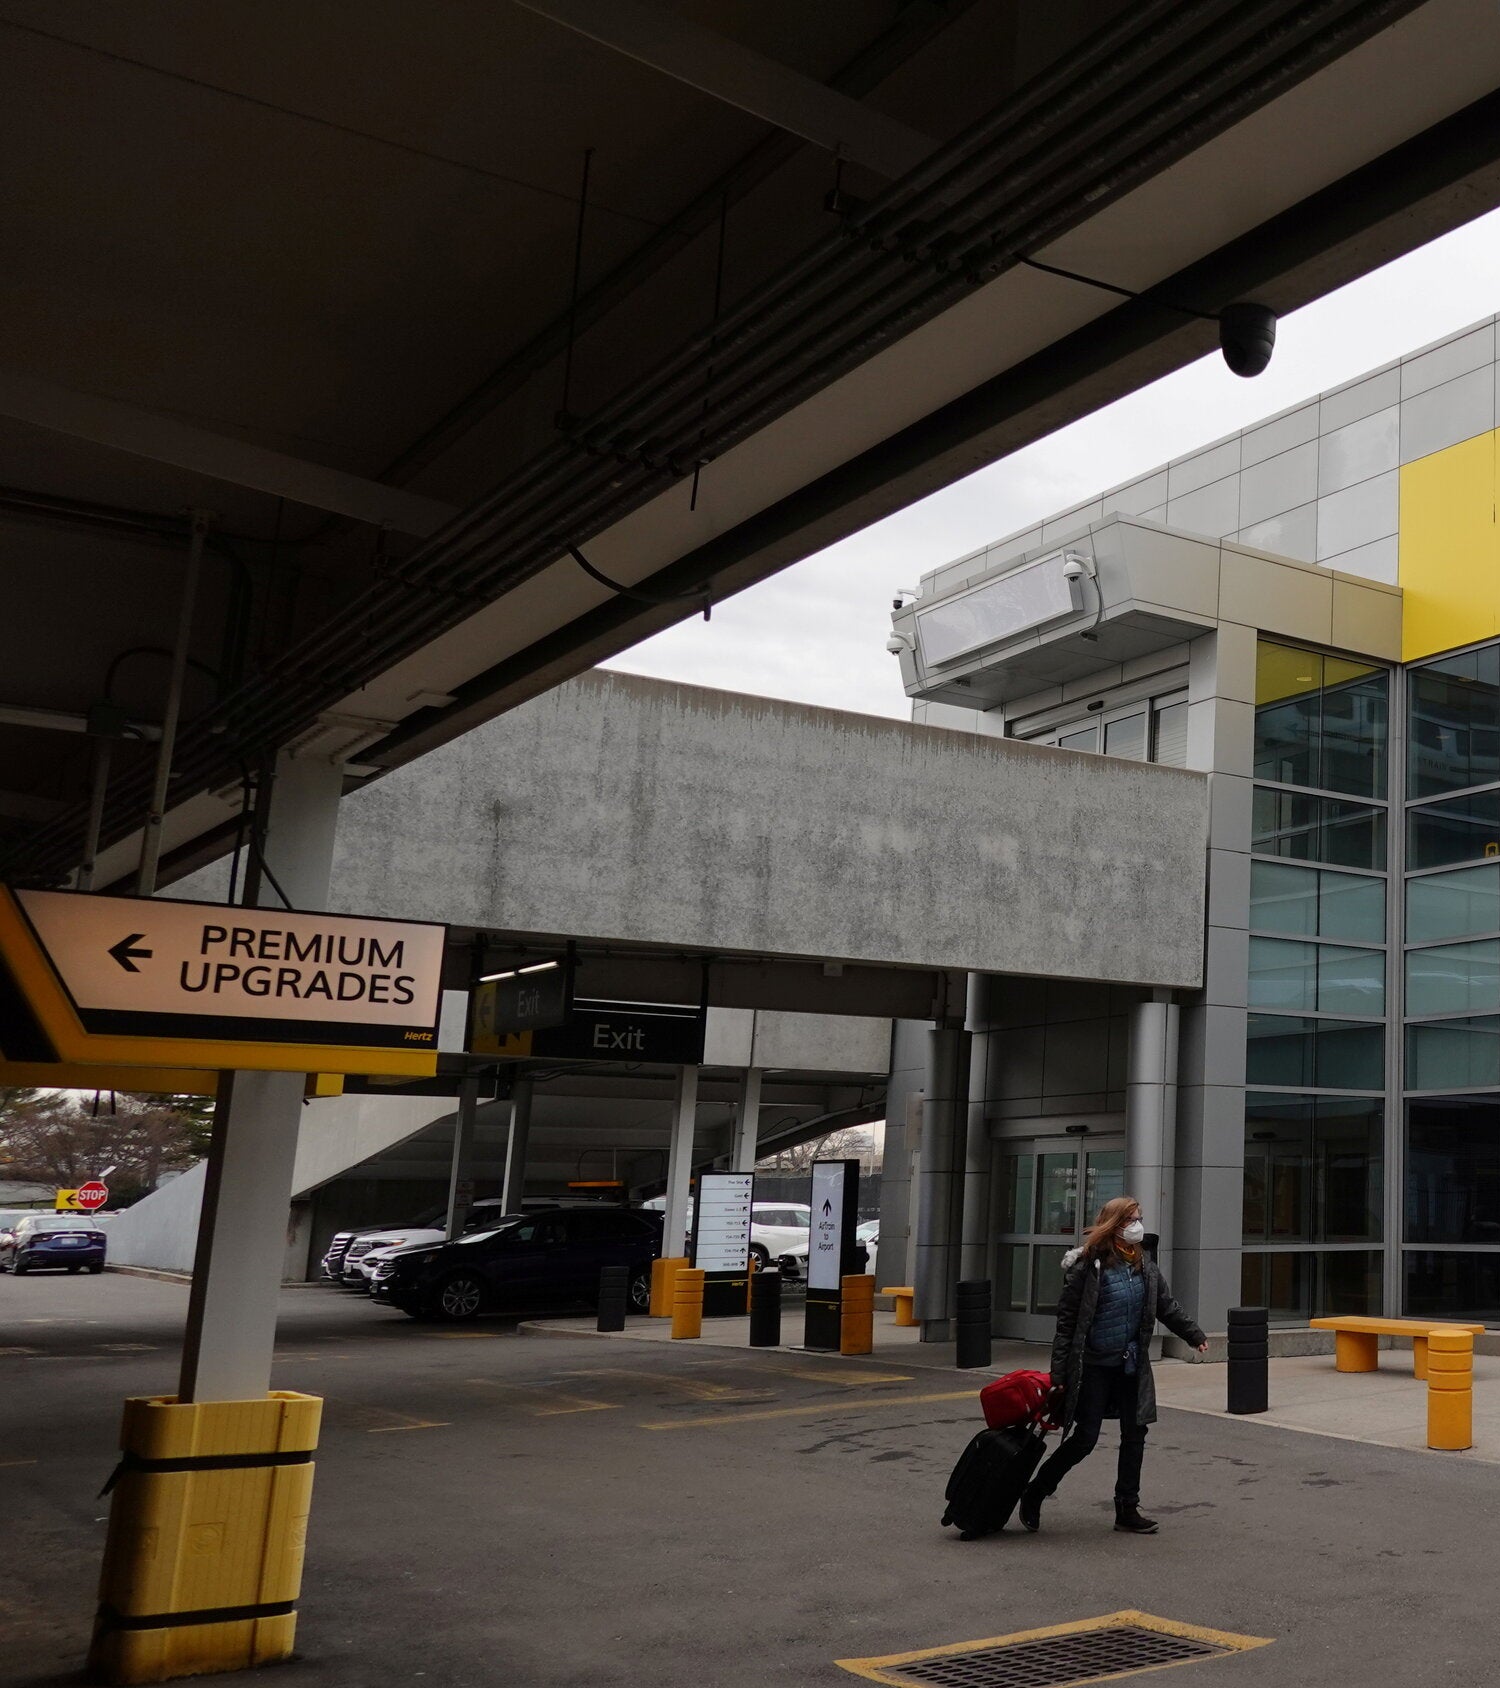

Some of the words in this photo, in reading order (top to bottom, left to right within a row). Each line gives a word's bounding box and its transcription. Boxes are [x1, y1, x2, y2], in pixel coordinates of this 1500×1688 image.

[200, 925, 405, 969] PREMIUM
[179, 961, 415, 1005] UPGRADES
[516, 988, 541, 1018] Exit
[404, 1031, 433, 1042] Hertz
[592, 1023, 646, 1050] Exit
[79, 1189, 105, 1201] STOP
[817, 1242, 834, 1252] Airport
